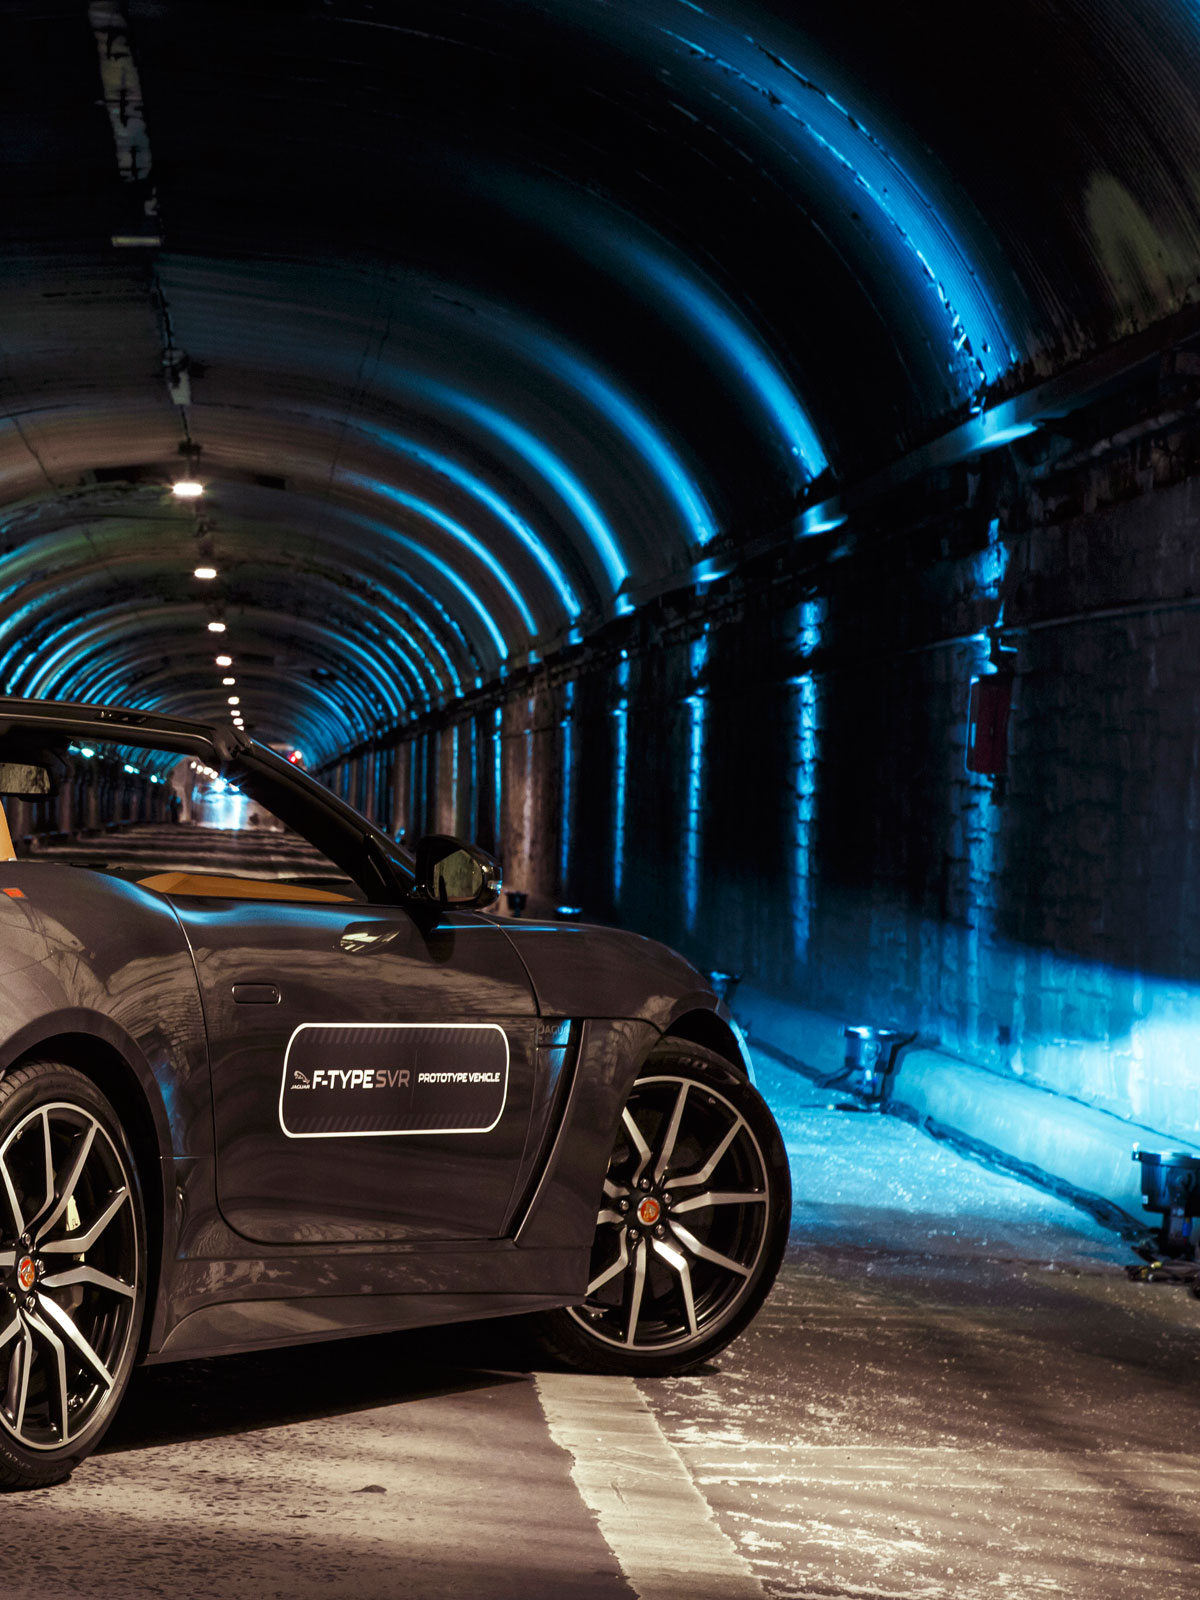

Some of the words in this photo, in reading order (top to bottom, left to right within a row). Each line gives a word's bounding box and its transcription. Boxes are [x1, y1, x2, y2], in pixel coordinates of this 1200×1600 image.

[312, 1069, 375, 1090] F-TYPE
[375, 1069, 410, 1088] SVR
[418, 1072, 468, 1083] PROTOTYPE
[468, 1072, 501, 1083] VEHICLE
